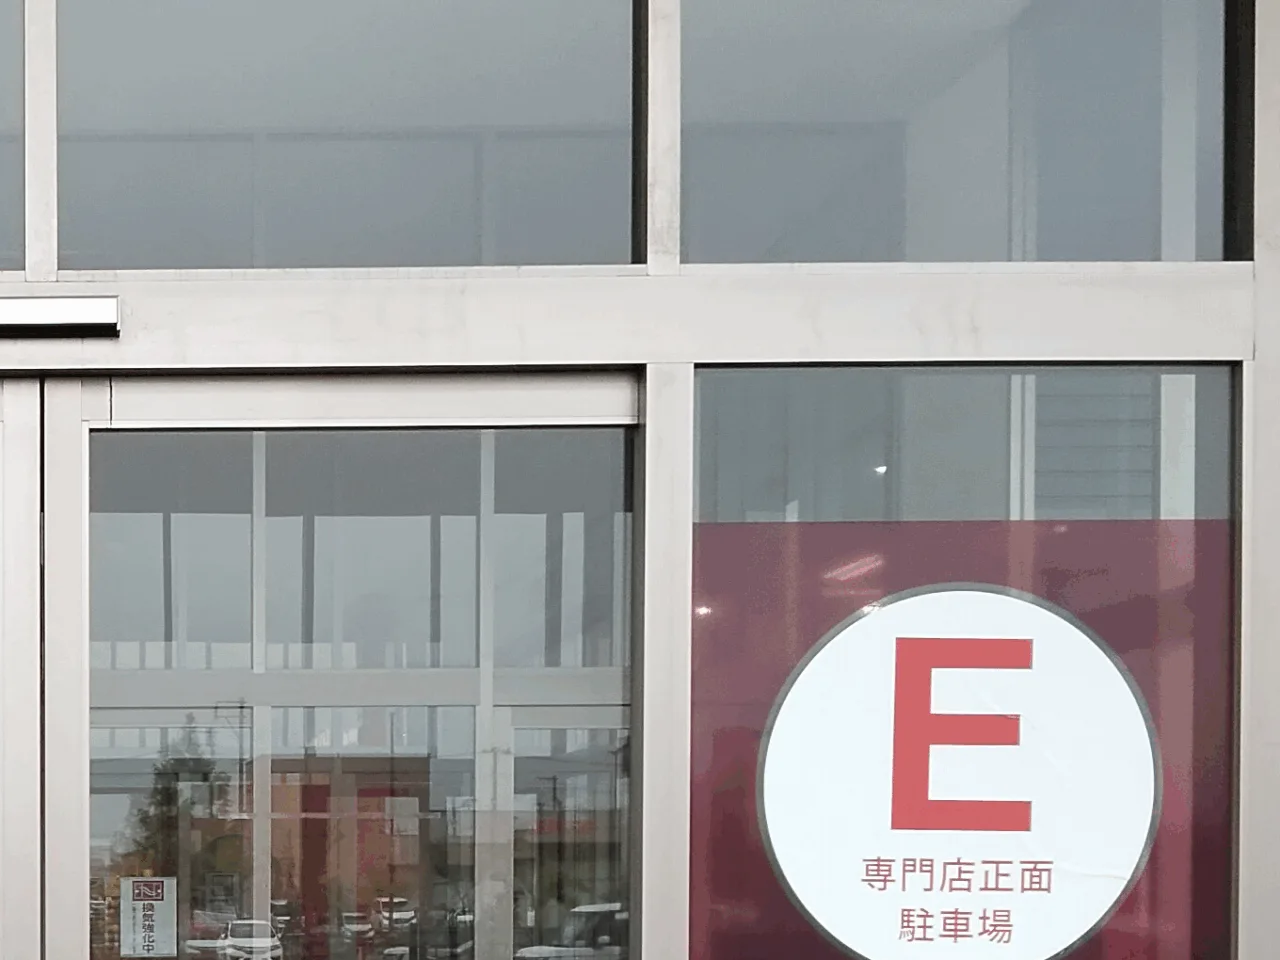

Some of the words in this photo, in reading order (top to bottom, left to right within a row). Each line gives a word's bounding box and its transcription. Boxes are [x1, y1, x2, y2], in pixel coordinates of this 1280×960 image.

[891, 637, 1034, 832] E
[860, 857, 1054, 895] 専門店正面
[142, 903, 155, 954] 換気強化中
[898, 908, 1014, 944] 駐車場
